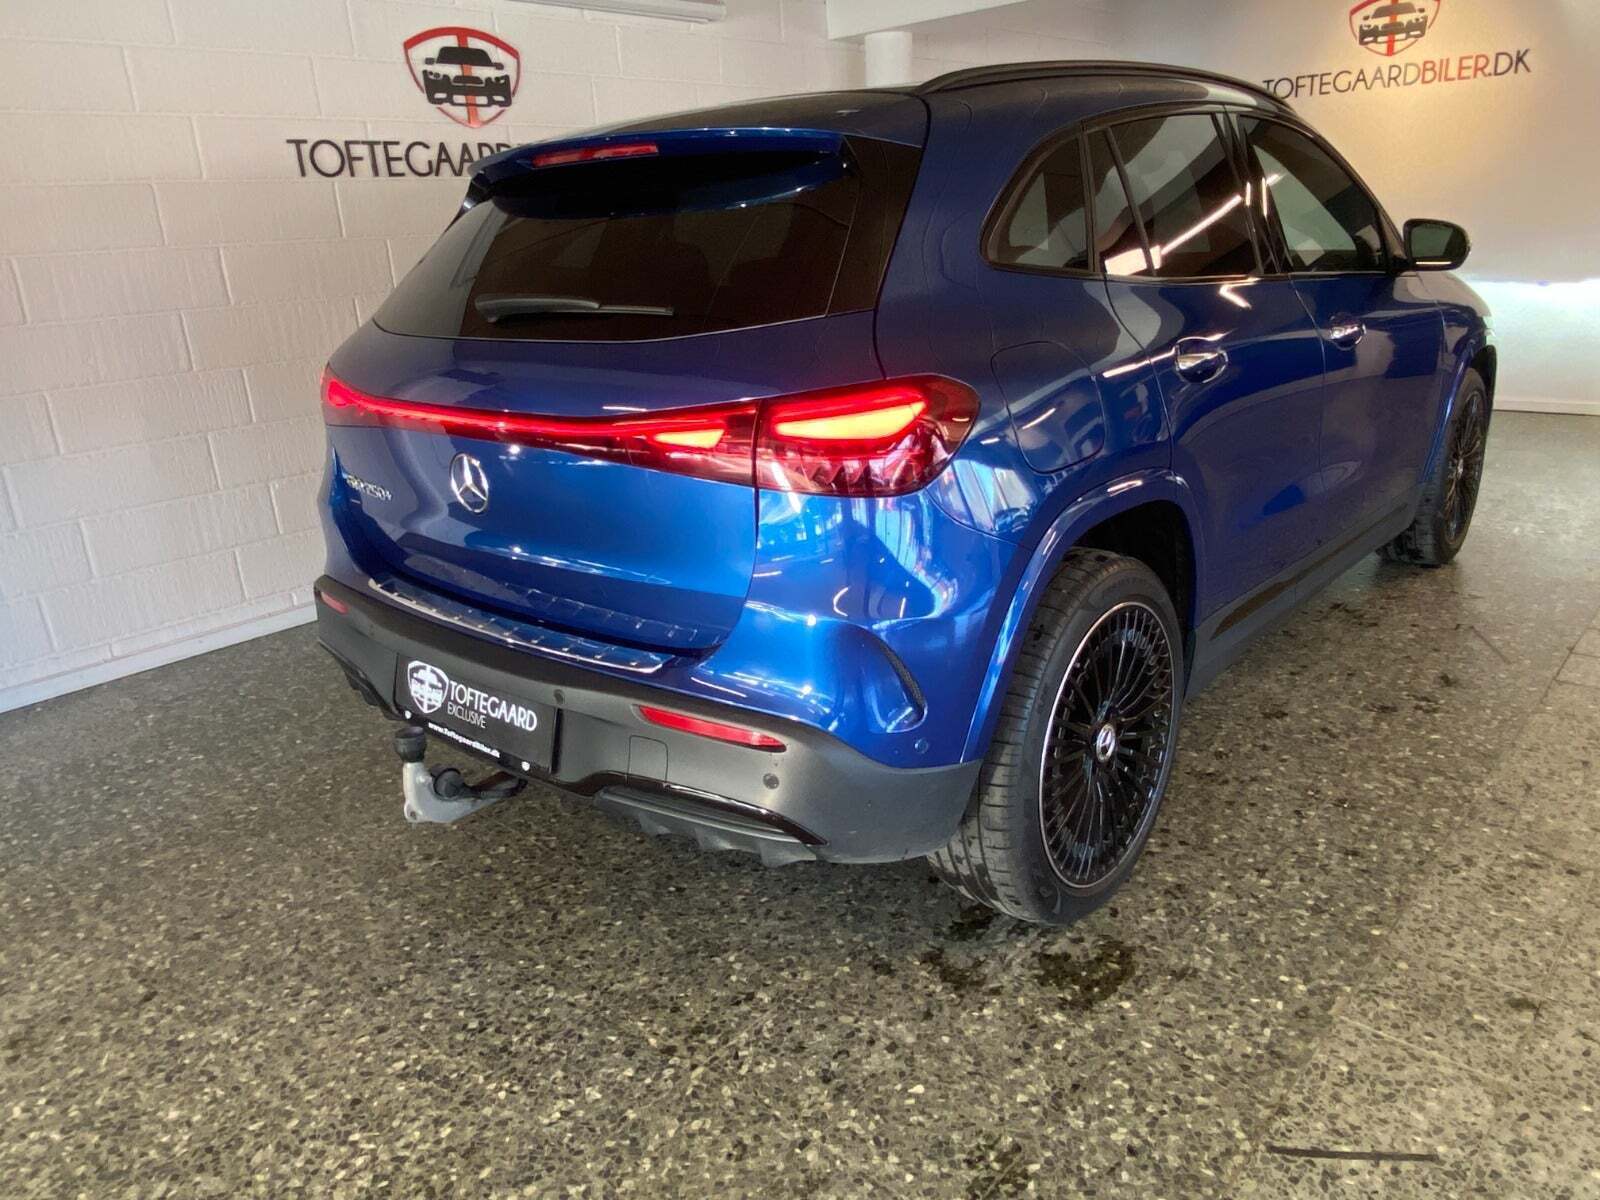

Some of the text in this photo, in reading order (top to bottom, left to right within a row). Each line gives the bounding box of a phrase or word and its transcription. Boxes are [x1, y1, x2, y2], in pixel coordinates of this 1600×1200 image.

[286, 139, 511, 177] TOFTEGAA
[447, 702, 486, 729] EXCLUSIVE
[450, 680, 537, 732] TOFTEGAARD
